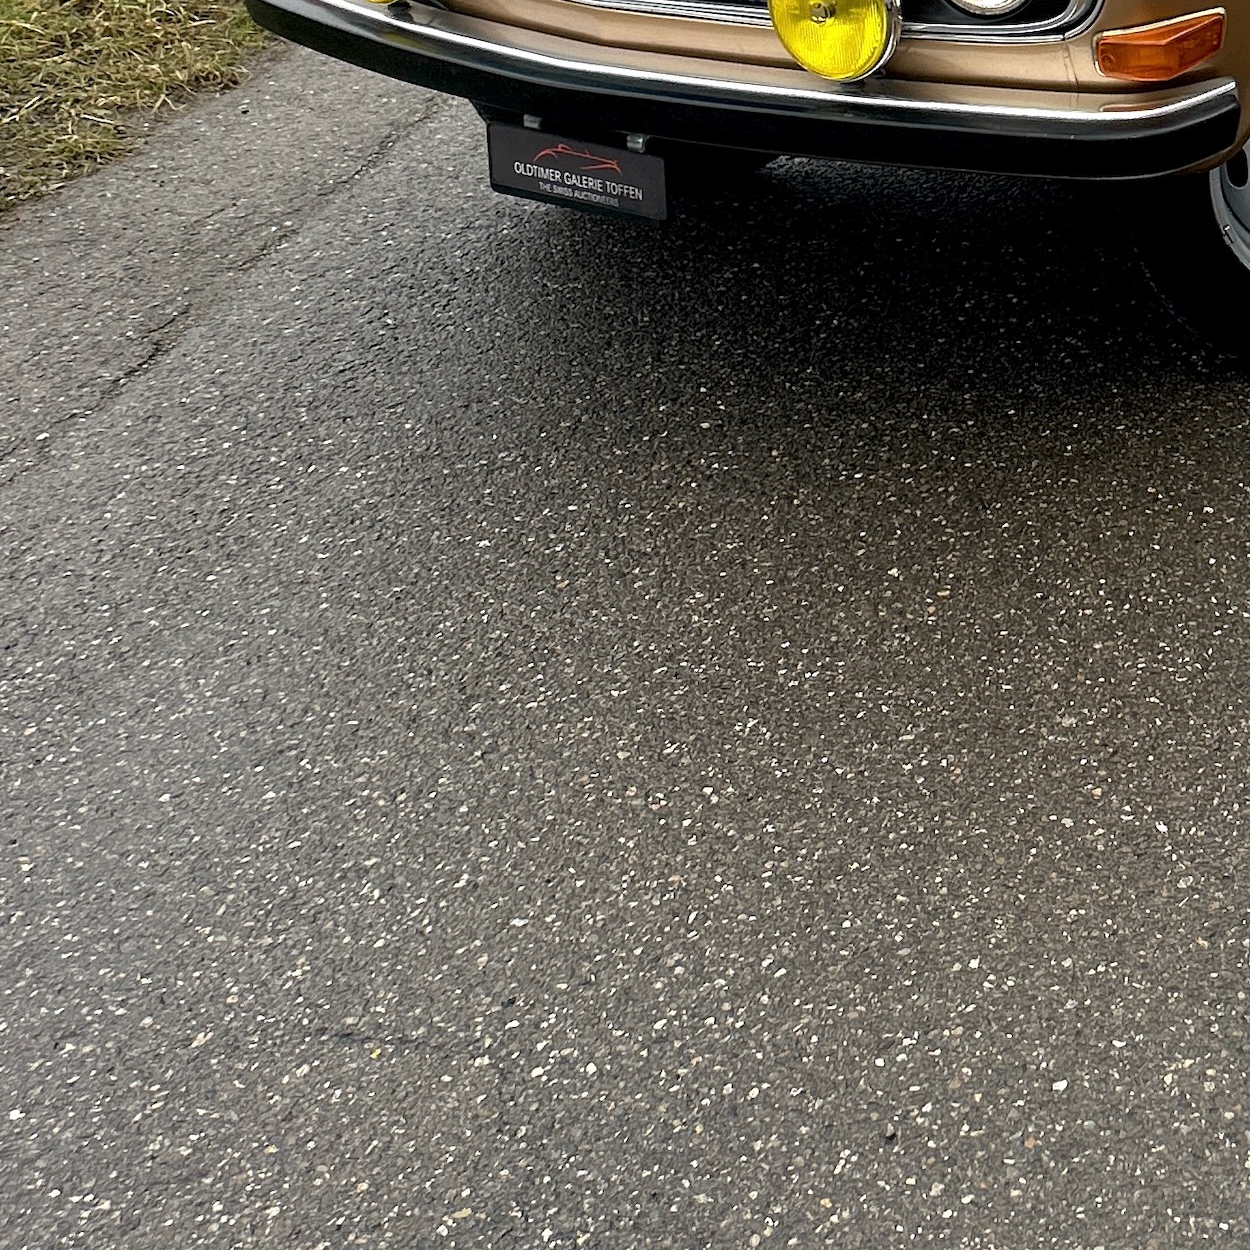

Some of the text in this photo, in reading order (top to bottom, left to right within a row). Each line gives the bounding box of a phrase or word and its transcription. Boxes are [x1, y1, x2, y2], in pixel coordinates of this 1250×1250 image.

[514, 161, 643, 200] OLDTIMER GALERIE TOFFEN
[538, 181, 552, 193] THE
[552, 185, 573, 197] SWISS
